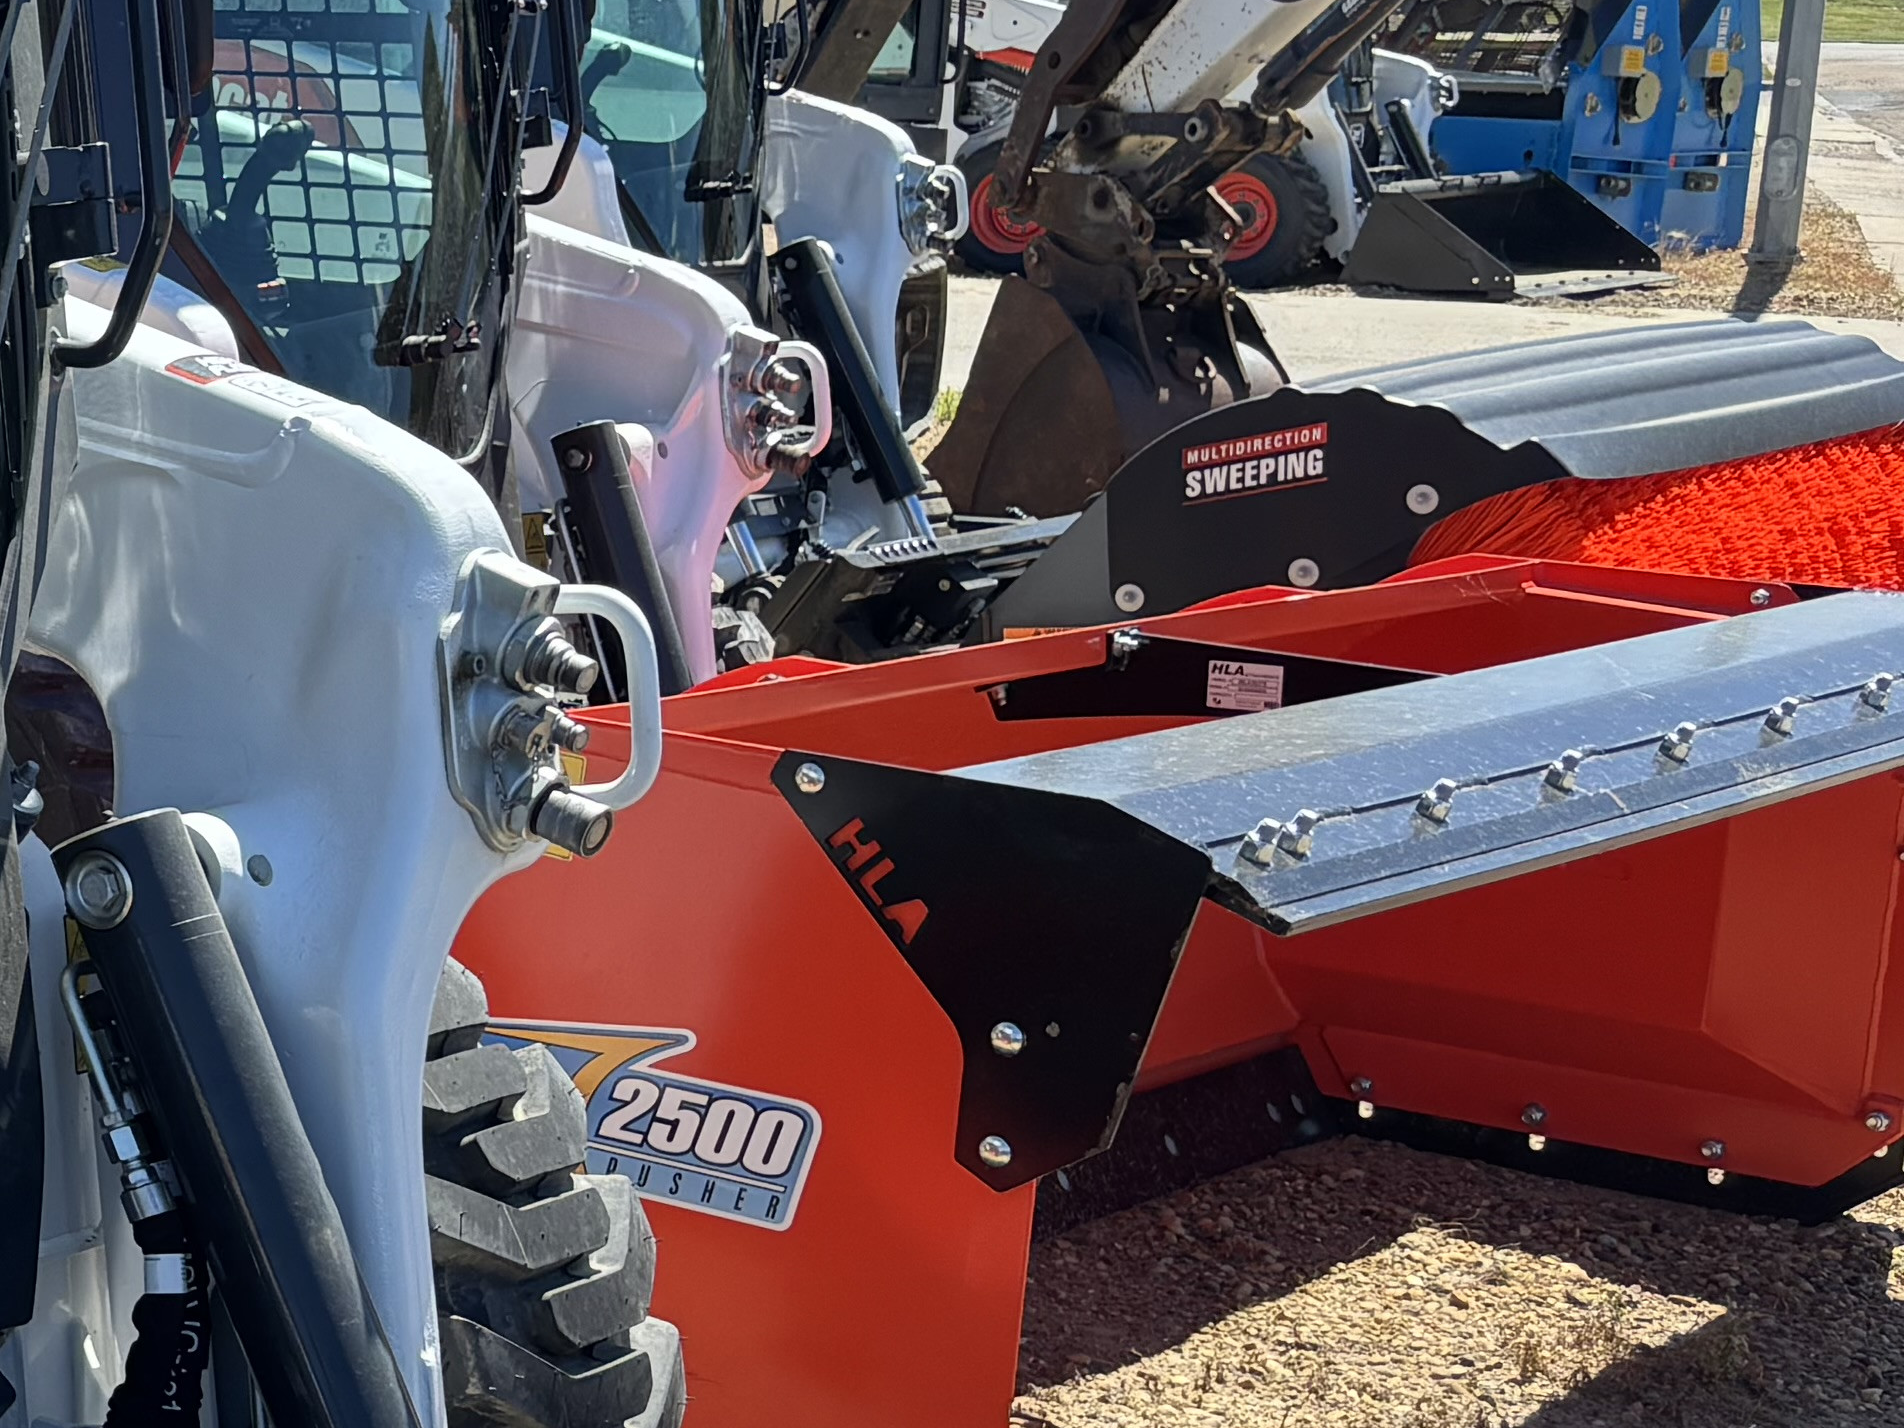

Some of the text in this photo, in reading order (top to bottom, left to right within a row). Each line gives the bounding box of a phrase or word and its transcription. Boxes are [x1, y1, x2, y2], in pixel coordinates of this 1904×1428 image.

[1185, 448, 1324, 498] SWEEPING
[1187, 426, 1322, 465] MULTIDIRECTION
[825, 817, 931, 946] HLA
[596, 1075, 807, 1178] 2500
